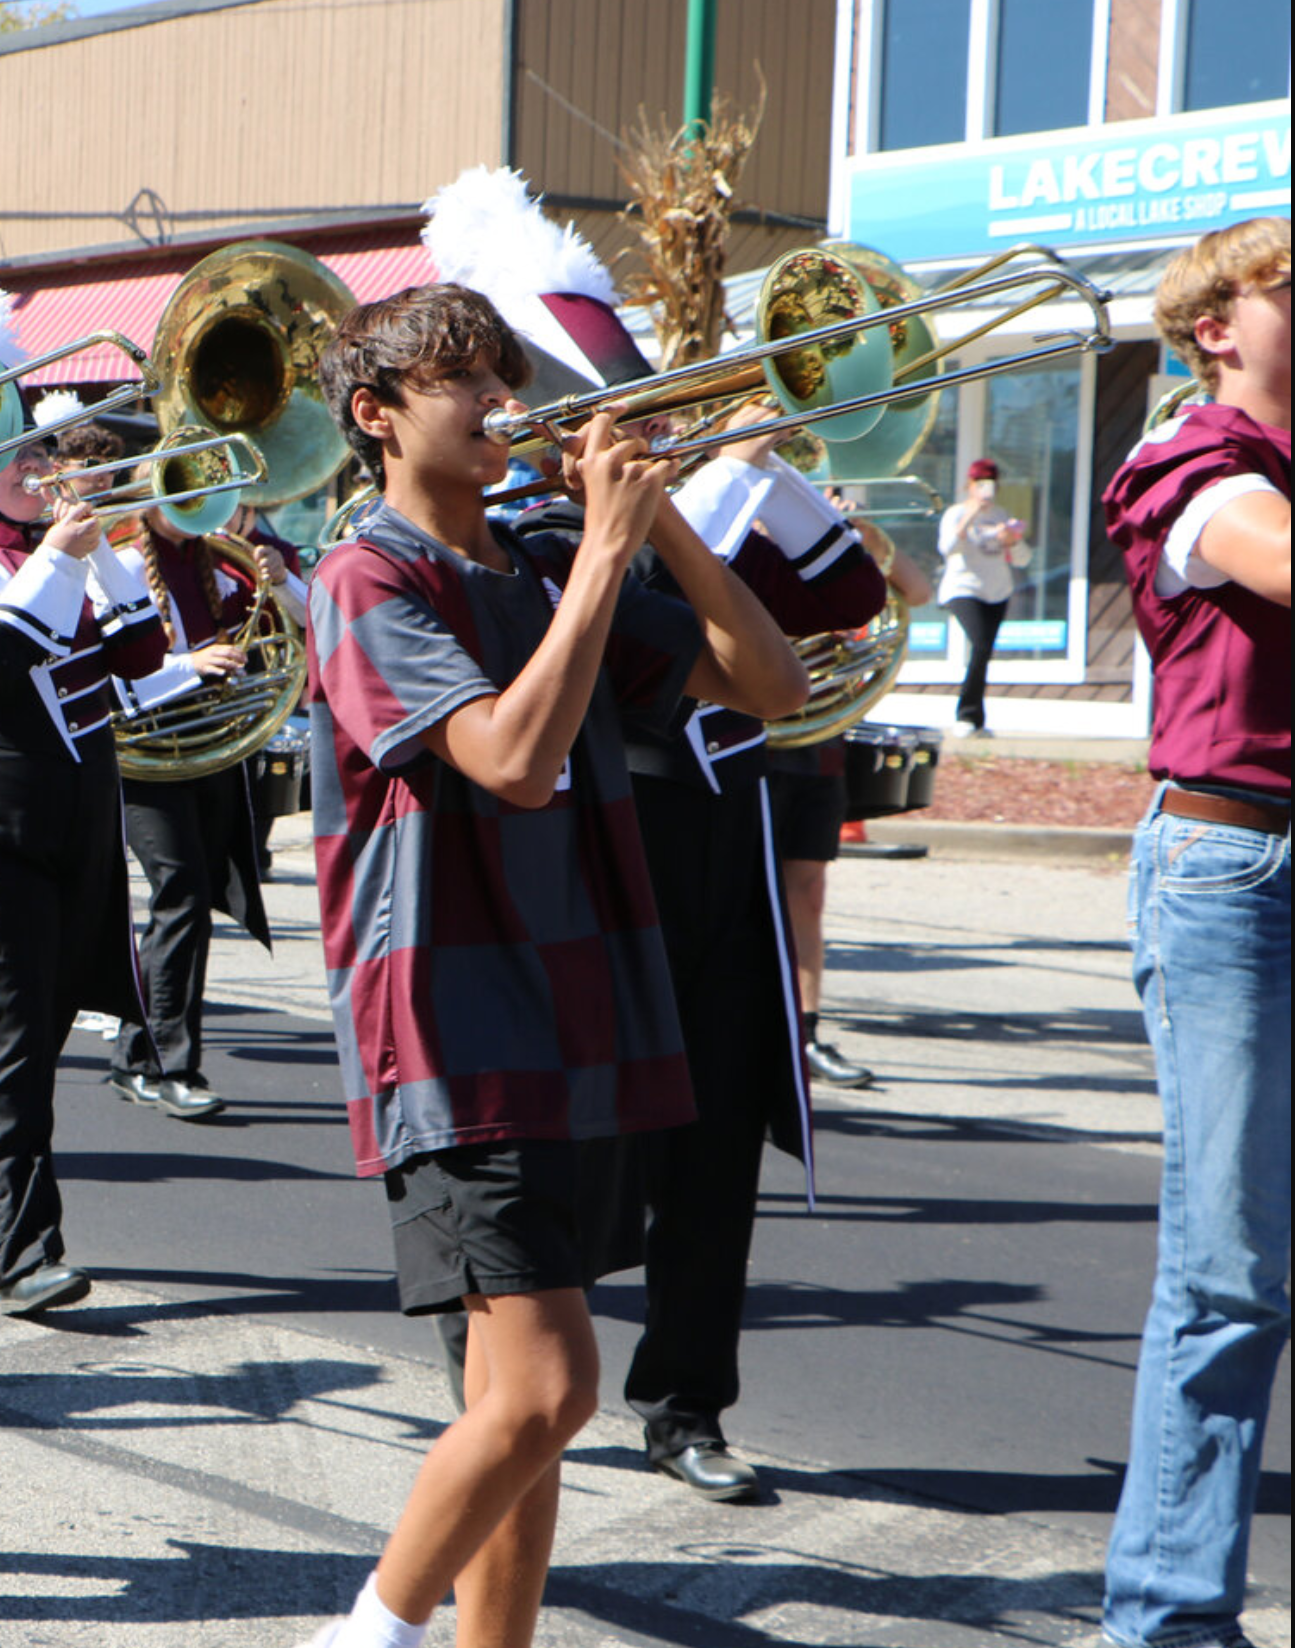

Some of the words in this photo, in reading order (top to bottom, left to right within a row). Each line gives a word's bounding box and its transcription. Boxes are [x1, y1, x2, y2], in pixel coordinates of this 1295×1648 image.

[1074, 206, 1087, 232] A
[1088, 202, 1137, 231] LOCAL
[1139, 196, 1182, 226] LAKE
[1183, 191, 1227, 221] SHOP
